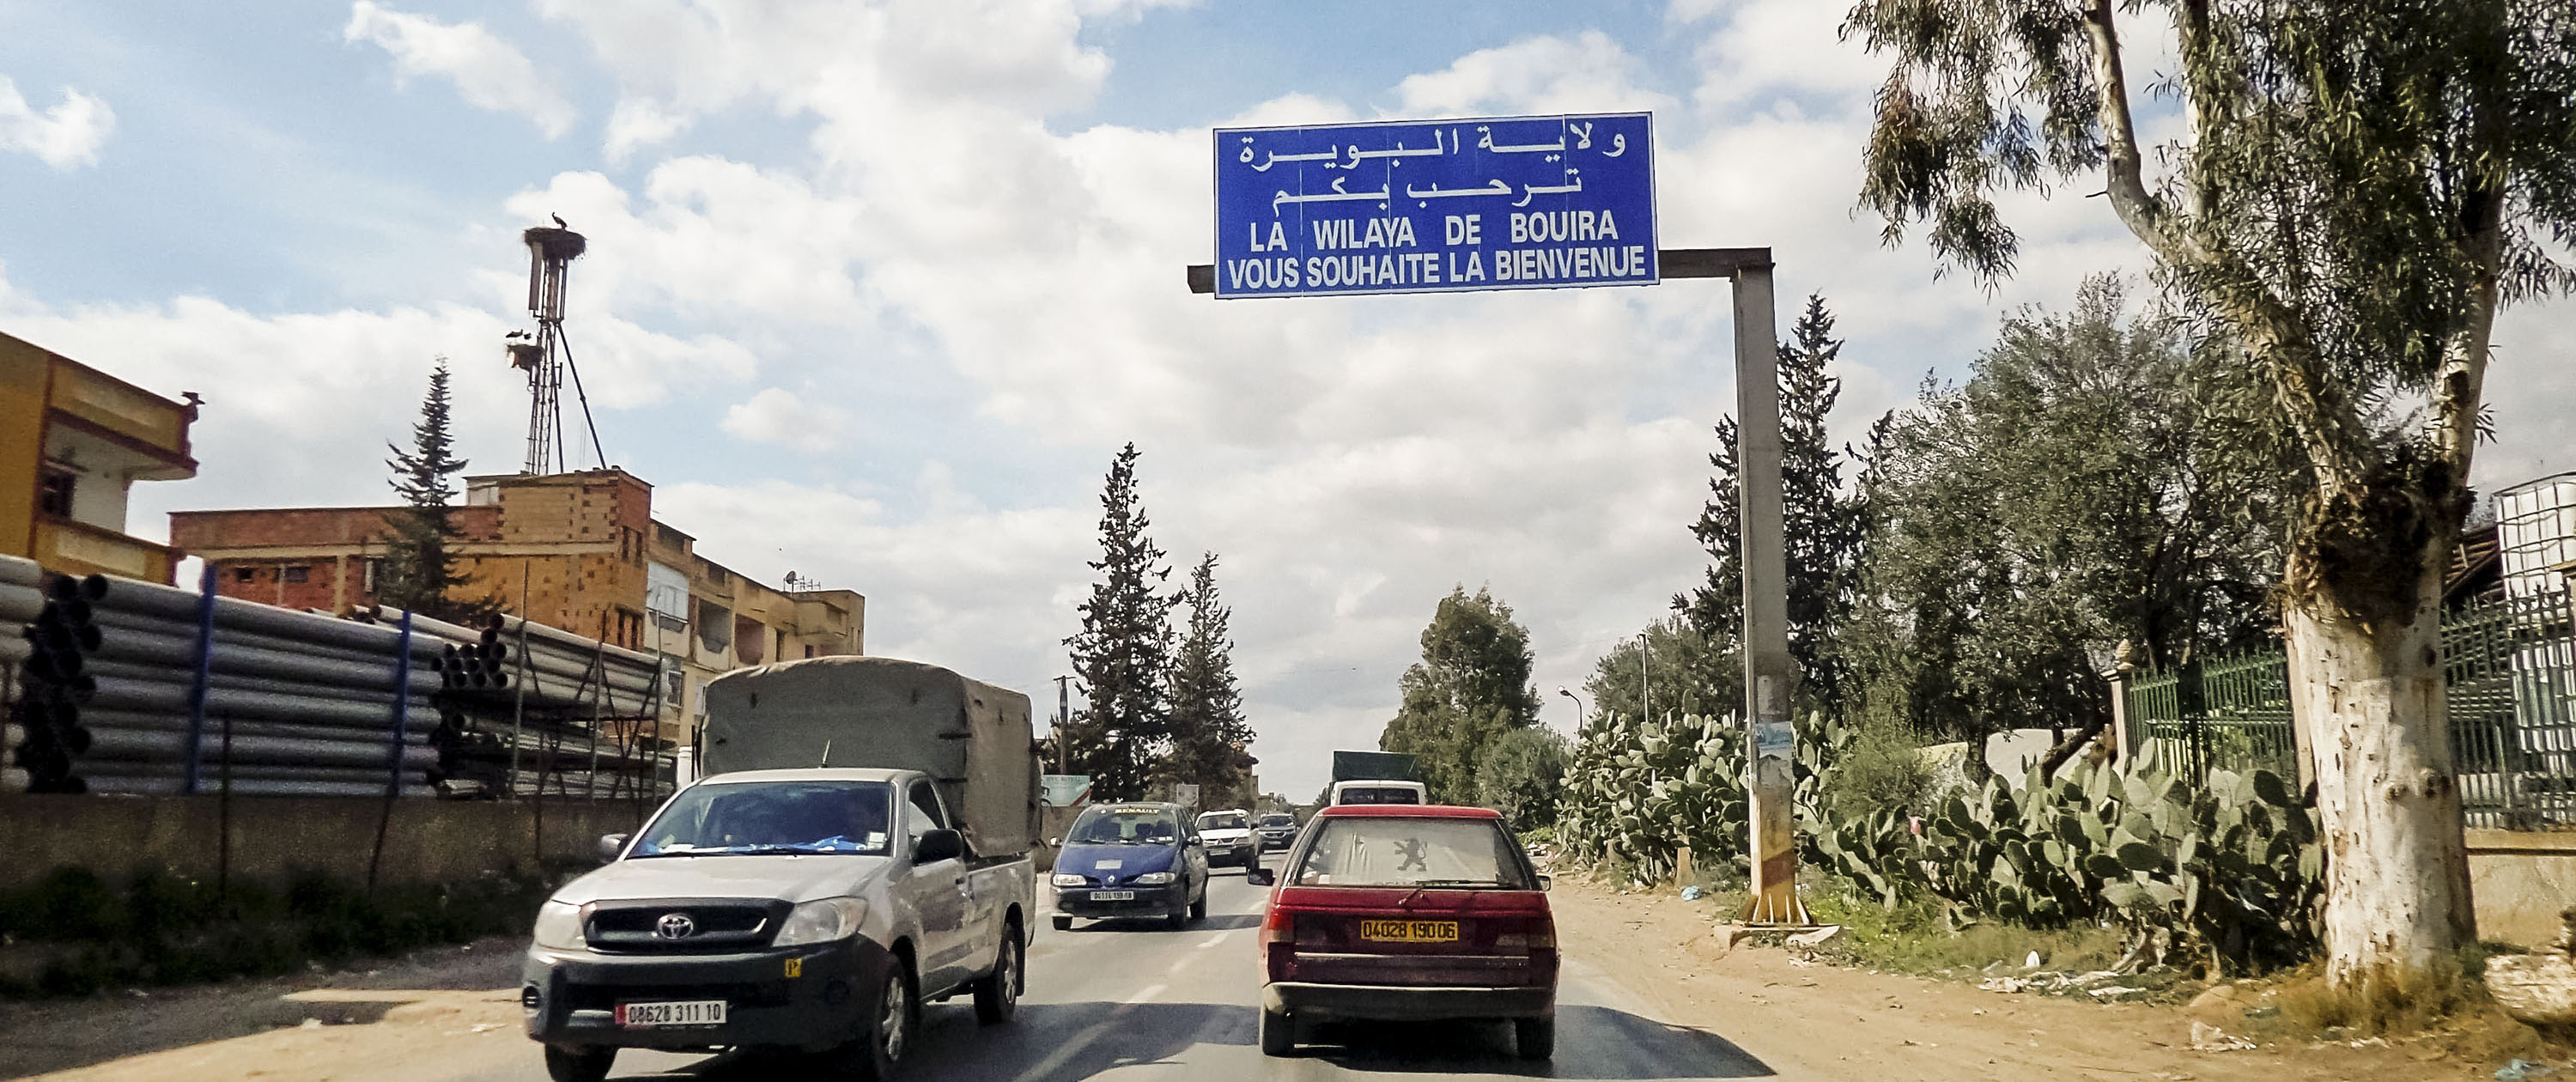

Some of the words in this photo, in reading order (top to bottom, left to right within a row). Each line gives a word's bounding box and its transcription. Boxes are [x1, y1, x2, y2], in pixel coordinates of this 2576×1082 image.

[1239, 128, 1459, 172] البويرة
[1477, 122, 1625, 162] ولاية
[1273, 176, 1390, 217] بكم
[1406, 167, 1582, 210] ترحب
[1250, 222, 1288, 252] LA
[1313, 216, 1417, 250] WILAYA
[1445, 214, 1481, 246] DE
[1510, 210, 1619, 243] BOUIRA
[1227, 258, 1300, 289] VOUS
[1307, 252, 1441, 288] SOUHAITE
[1449, 252, 1486, 283] LA
[1495, 246, 1646, 281] BIENVENUE
[1363, 921, 1407, 938] 04028
[675, 1004, 699, 1022] 311
[707, 1003, 721, 1020] 10
